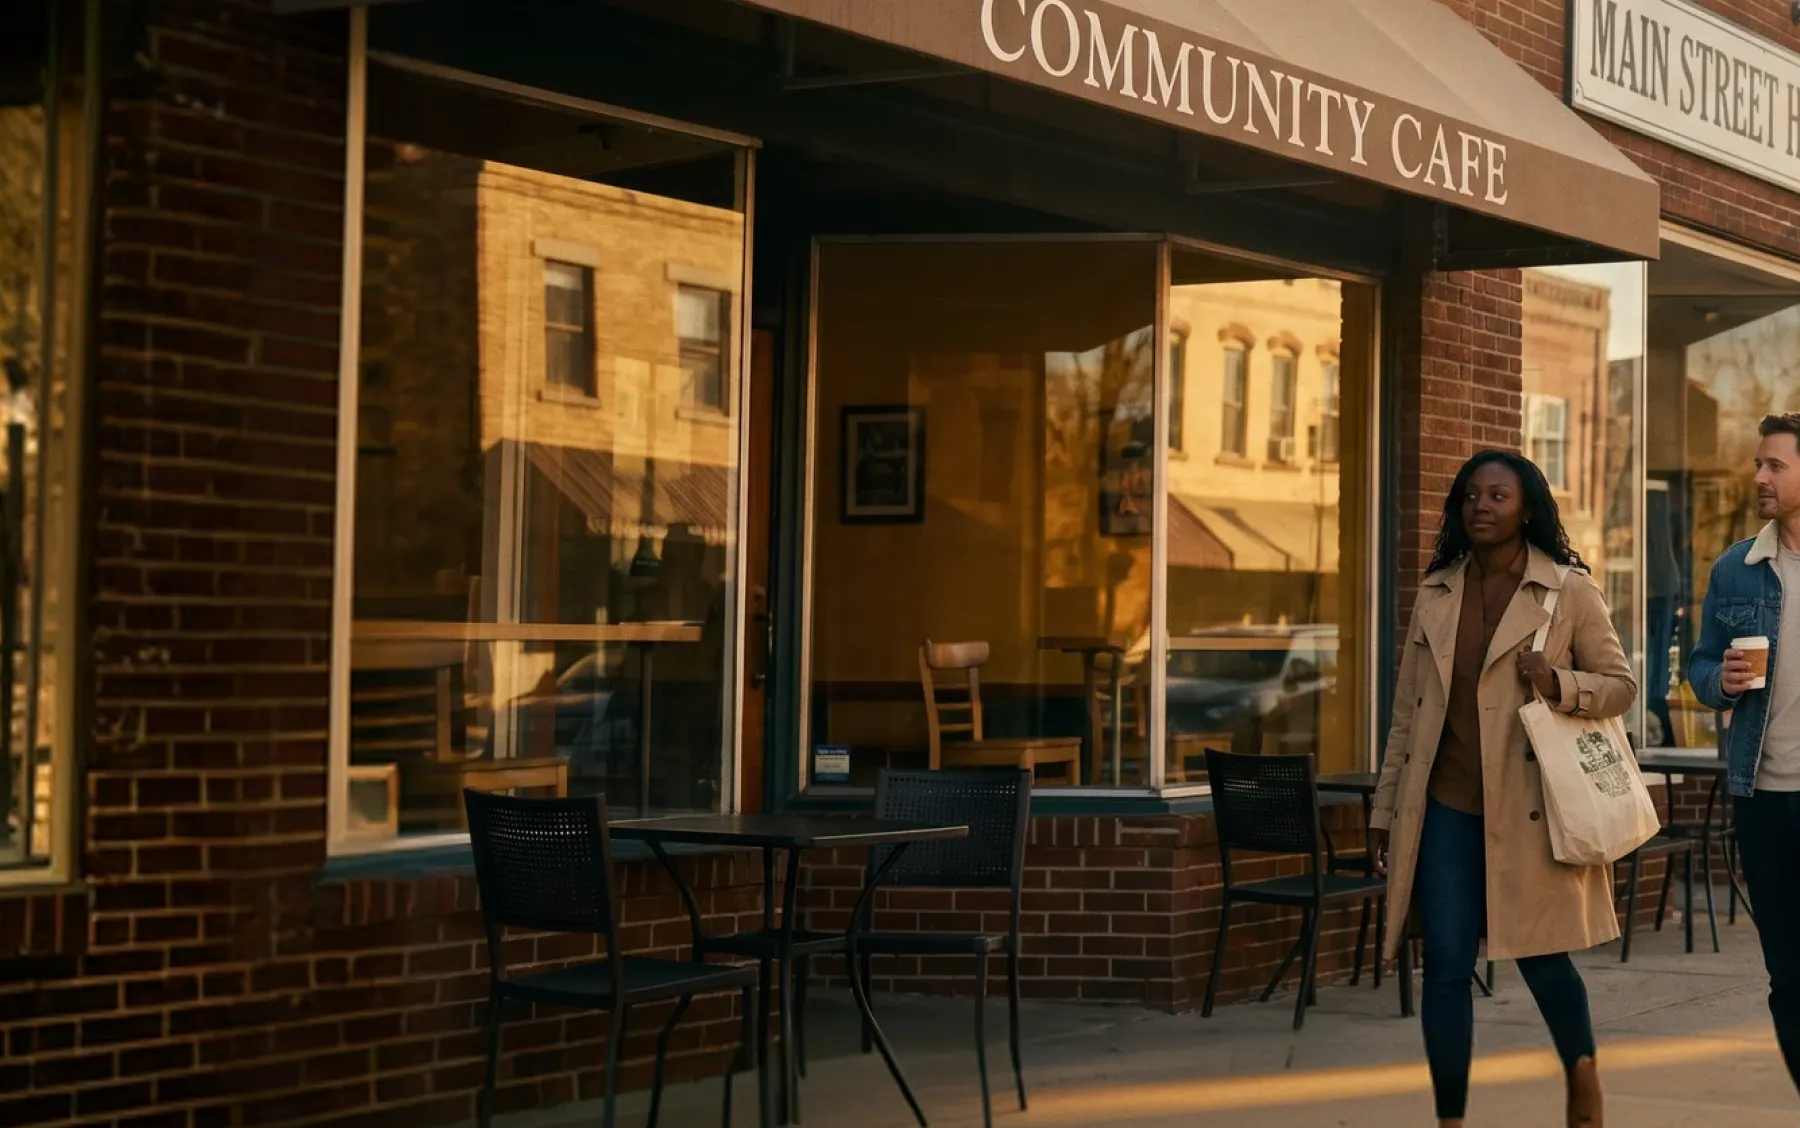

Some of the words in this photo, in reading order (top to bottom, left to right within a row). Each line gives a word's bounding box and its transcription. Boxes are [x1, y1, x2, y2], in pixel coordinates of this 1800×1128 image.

[981, 0, 1376, 167] COMMUNITY
[1391, 113, 1508, 206] CAFE
[1590, 0, 1670, 107] MAIN
[1679, 34, 1779, 149] STREET
